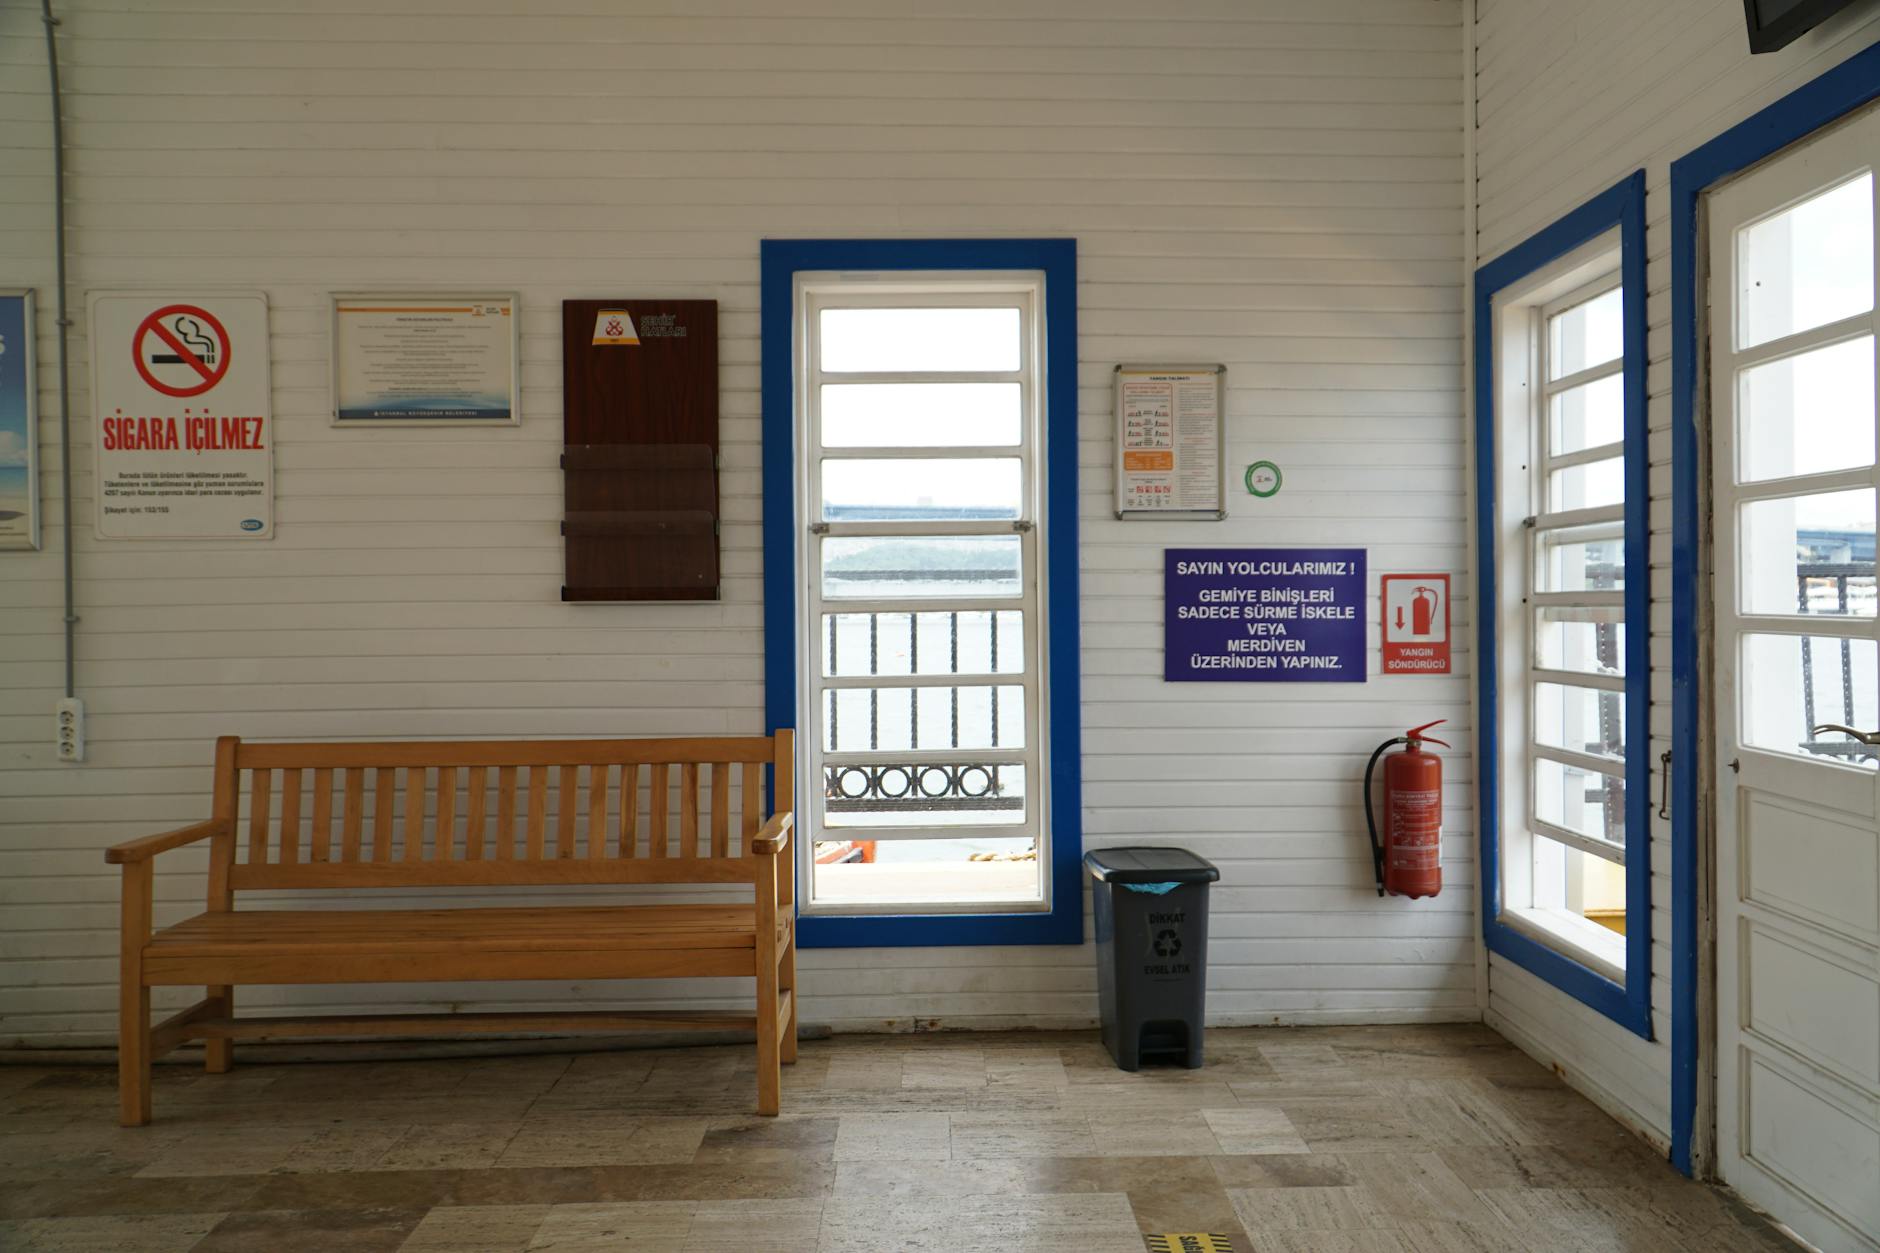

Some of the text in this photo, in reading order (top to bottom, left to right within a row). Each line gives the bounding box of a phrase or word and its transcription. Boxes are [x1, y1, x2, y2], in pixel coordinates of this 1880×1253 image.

[103, 408, 265, 456] SİGARA İÇİLMEZ
[1177, 562, 1355, 575] SAYIN YOLCULARIMIZ !
[1199, 587, 1335, 606] GEMİYE BİNİŞLERİ
[1178, 603, 1355, 619] SADECE SÜRME İSKELE
[1246, 623, 1287, 635] VEYA
[1227, 637, 1306, 652] MERDİVEN
[1400, 648, 1434, 657] YANGIN
[1190, 653, 1343, 669] ÜZERİNDEN YAPINIZ.
[1388, 659, 1446, 669] SÖNDÜRÜCÜ
[1149, 912, 1185, 924] DİKKAT
